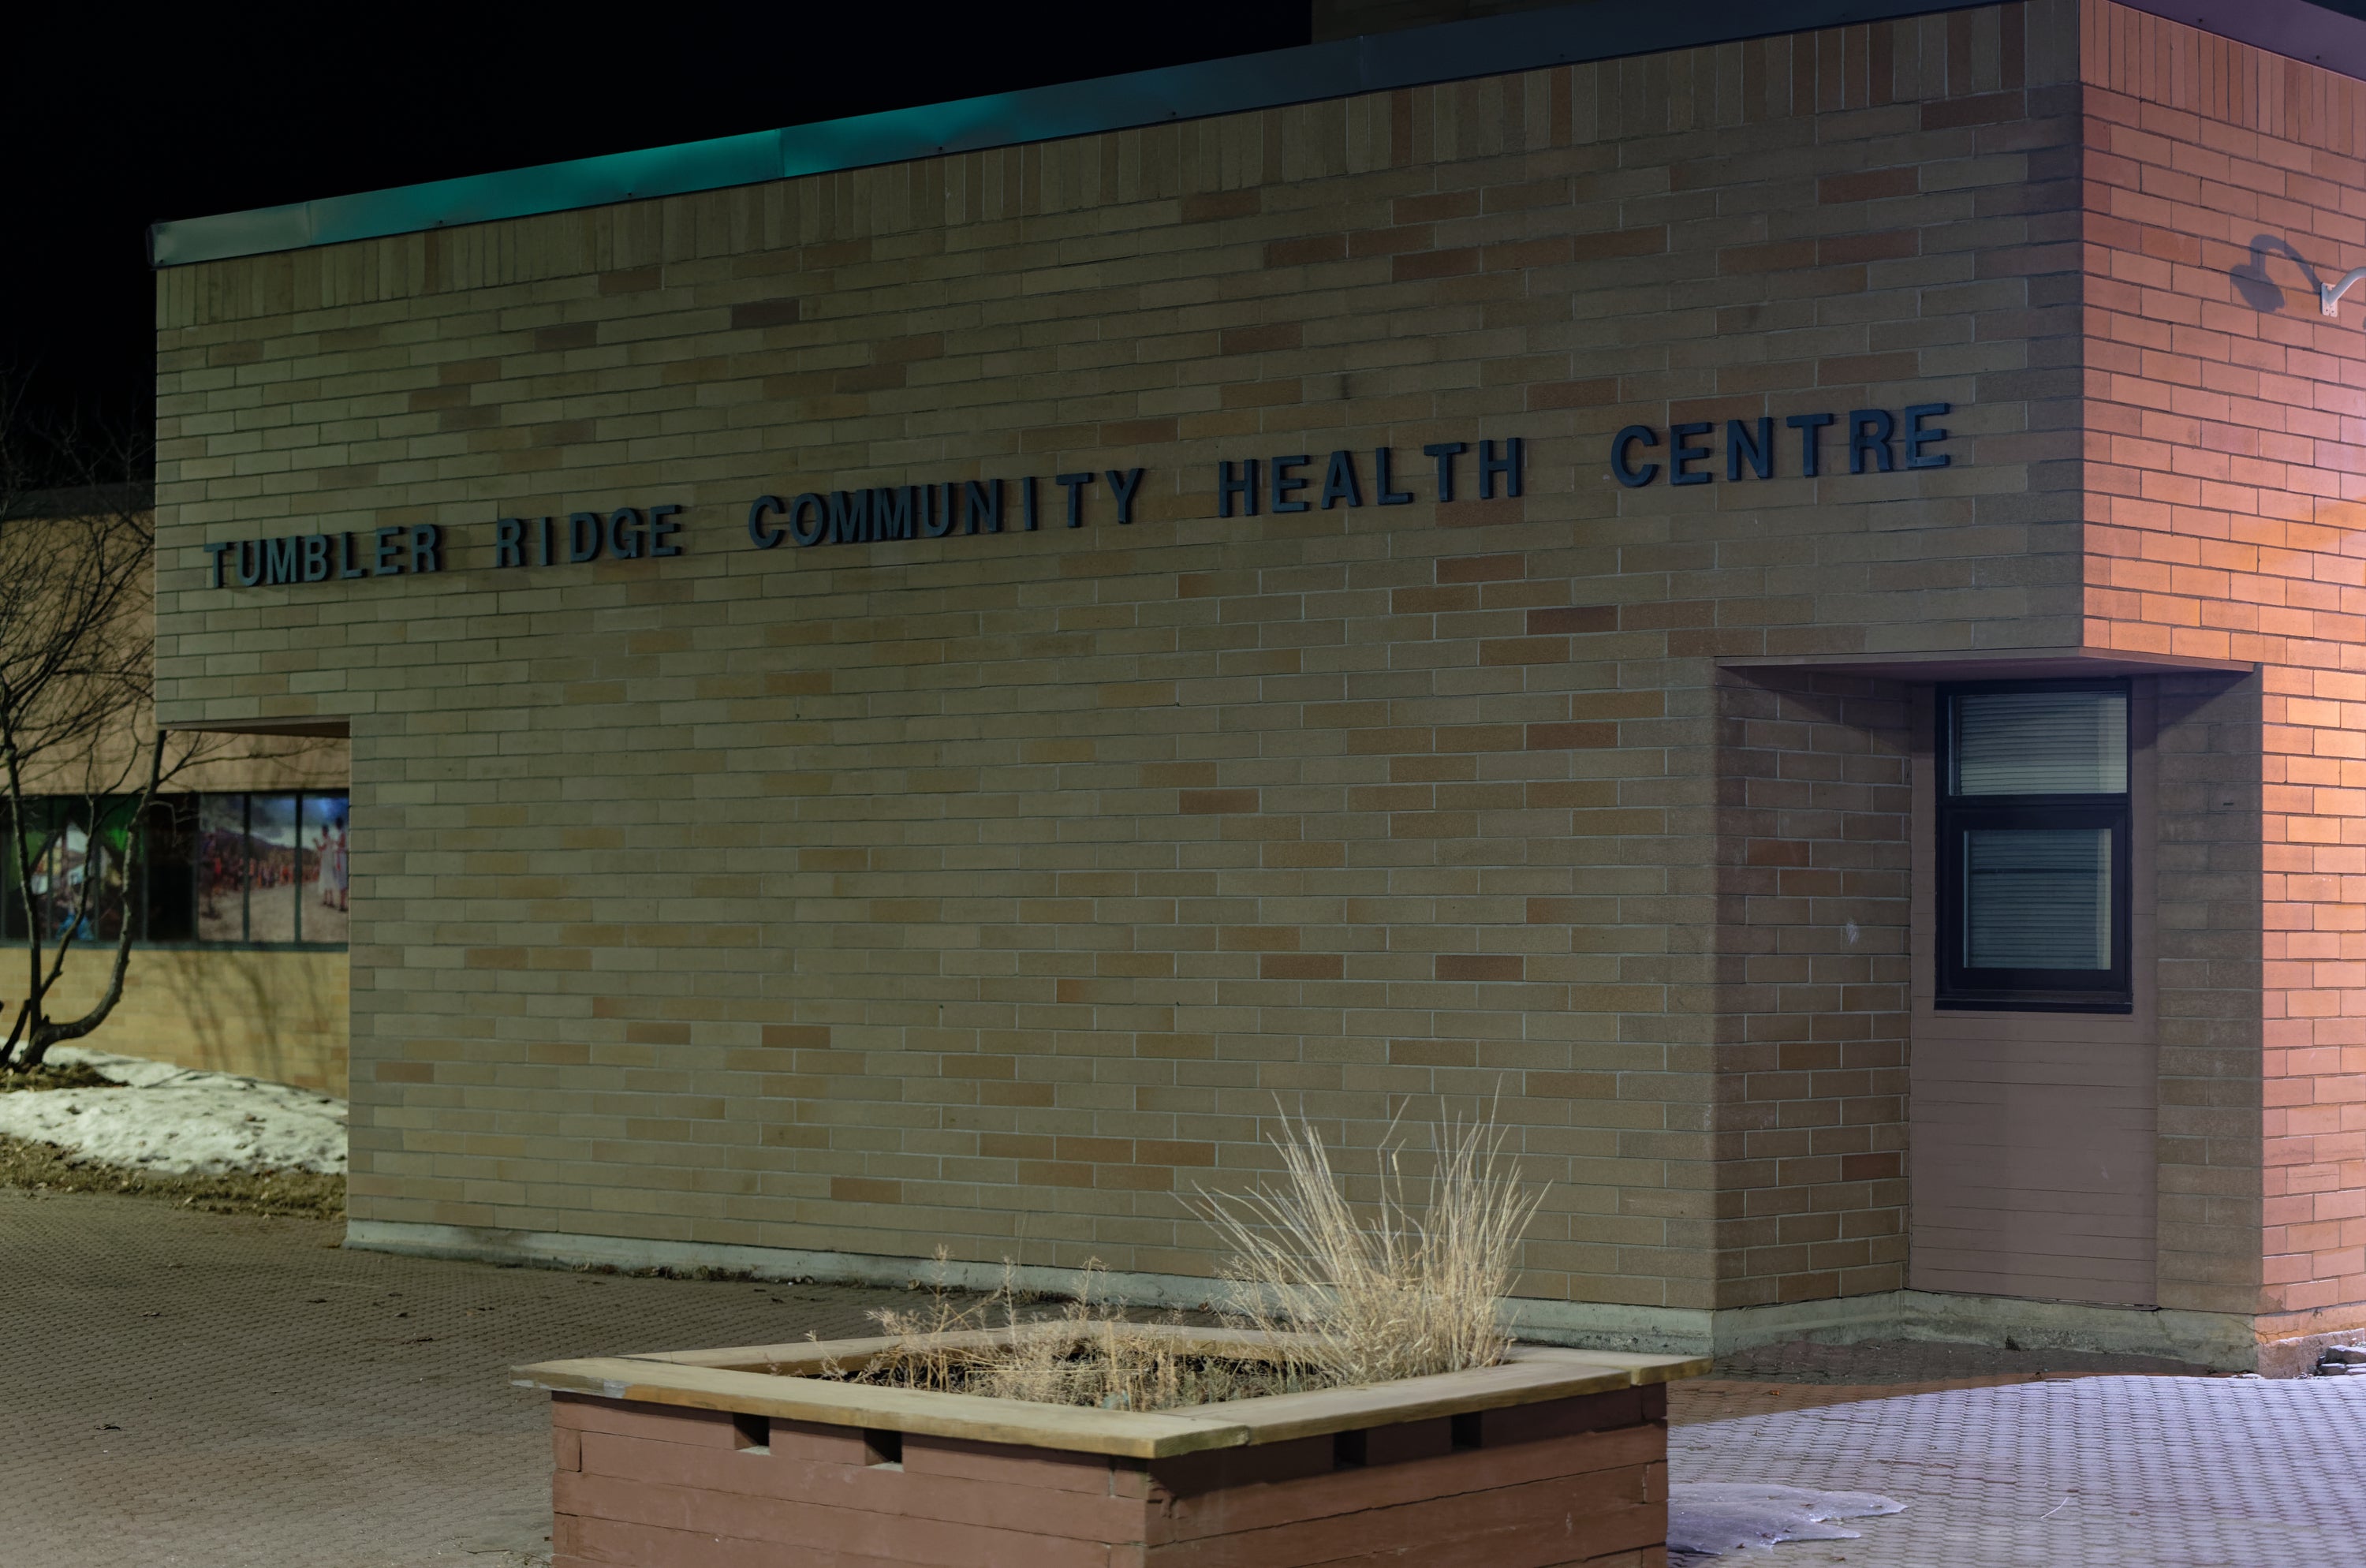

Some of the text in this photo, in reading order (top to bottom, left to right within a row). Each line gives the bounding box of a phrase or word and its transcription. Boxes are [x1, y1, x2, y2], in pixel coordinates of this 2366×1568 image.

[204, 402, 1951, 589] TUMBLER RIDGE COMMUNITY HEALTH CENTRE
